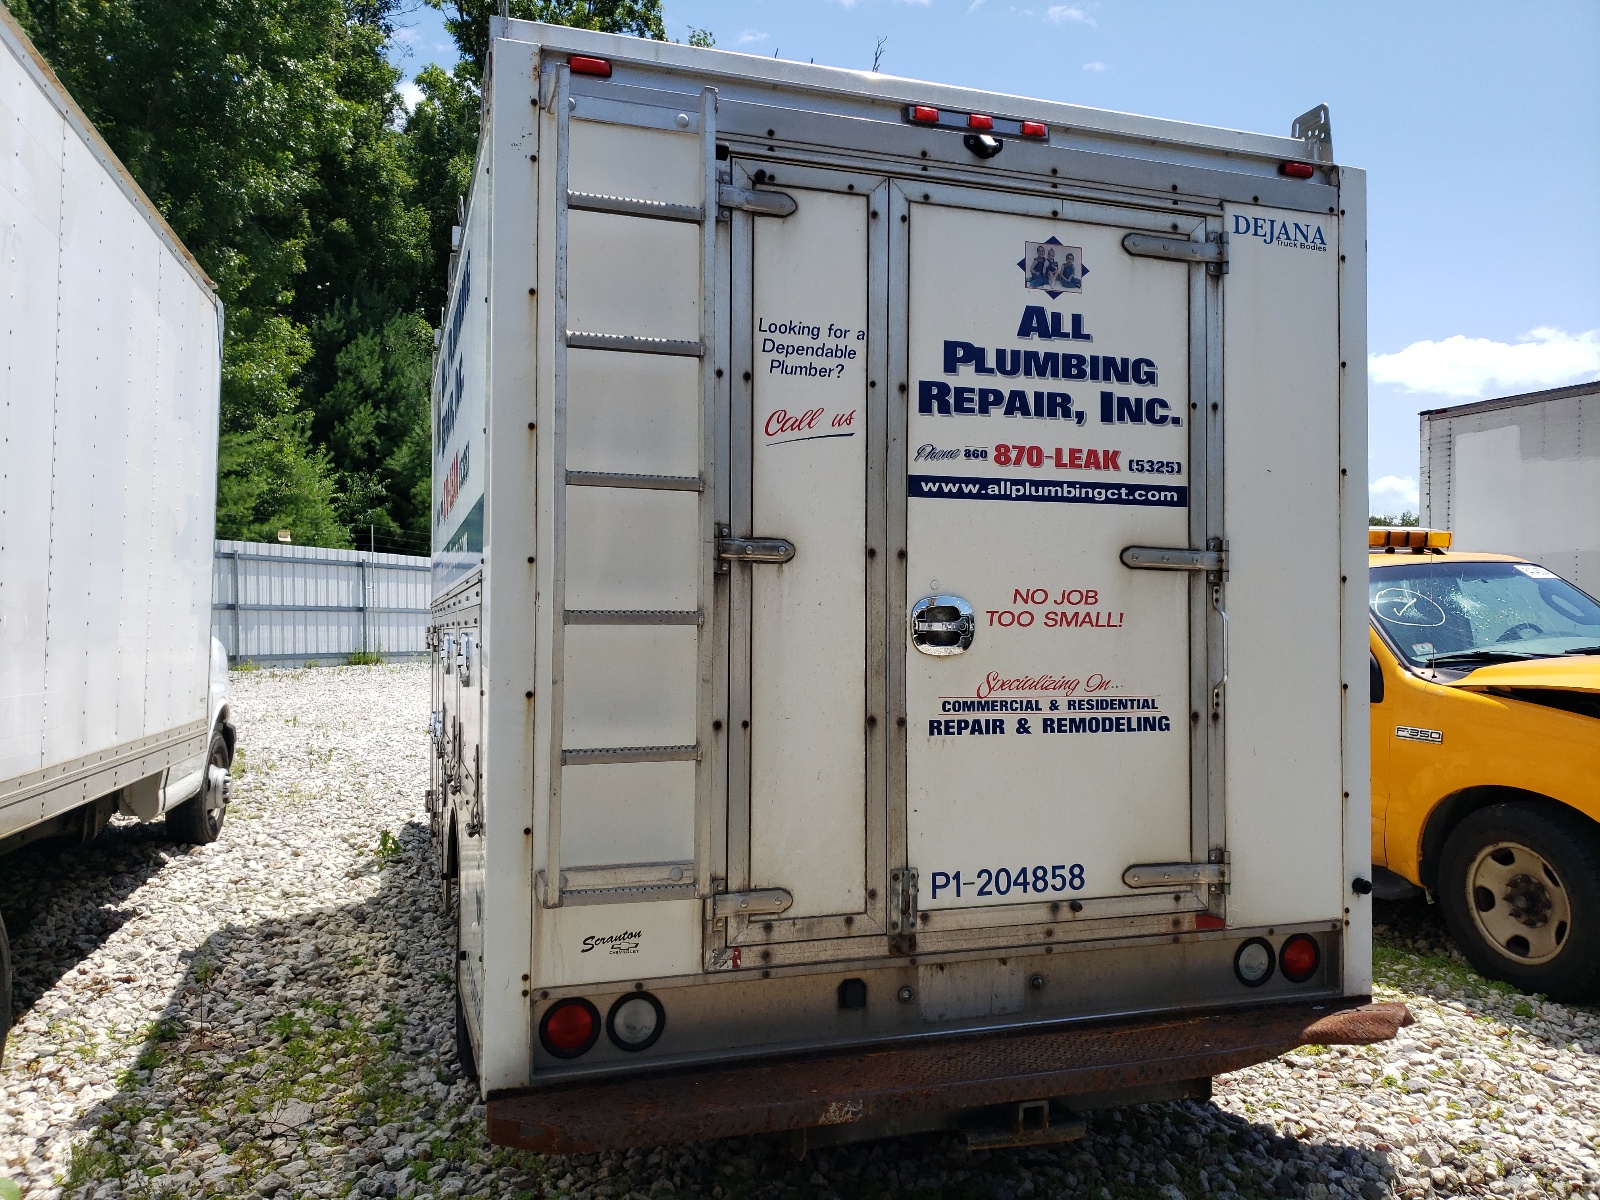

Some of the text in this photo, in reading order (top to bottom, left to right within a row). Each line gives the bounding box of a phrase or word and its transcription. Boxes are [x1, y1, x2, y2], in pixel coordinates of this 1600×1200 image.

[1233, 214, 1327, 245] DEJANA
[1276, 239, 1327, 252] Truck Bodies
[758, 317, 866, 340] Looking for a
[1016, 304, 1093, 342] ALL
[762, 338, 857, 360] Dependable
[769, 359, 845, 378] Plumber?
[943, 340, 1158, 386] PLUMBING
[918, 380, 1183, 427] REPAIR, INC.
[764, 408, 856, 436] Call us
[914, 444, 961, 462] Phone
[963, 448, 988, 459] 860
[993, 443, 1122, 471] 870-LEAK
[920, 480, 1178, 502] www.allplumbingct.com
[1012, 588, 1099, 605] NO JOB
[985, 610, 1125, 628] TOO SMALL!
[976, 670, 1080, 699] Specializing
[941, 698, 1159, 713] COMMERCIAL & RESIDENTIAL
[928, 715, 1171, 736] REPAIR & REMODELING
[1396, 727, 1441, 739] F-350
[931, 863, 1086, 899] P1-204858
[580, 930, 643, 953] Scranton
